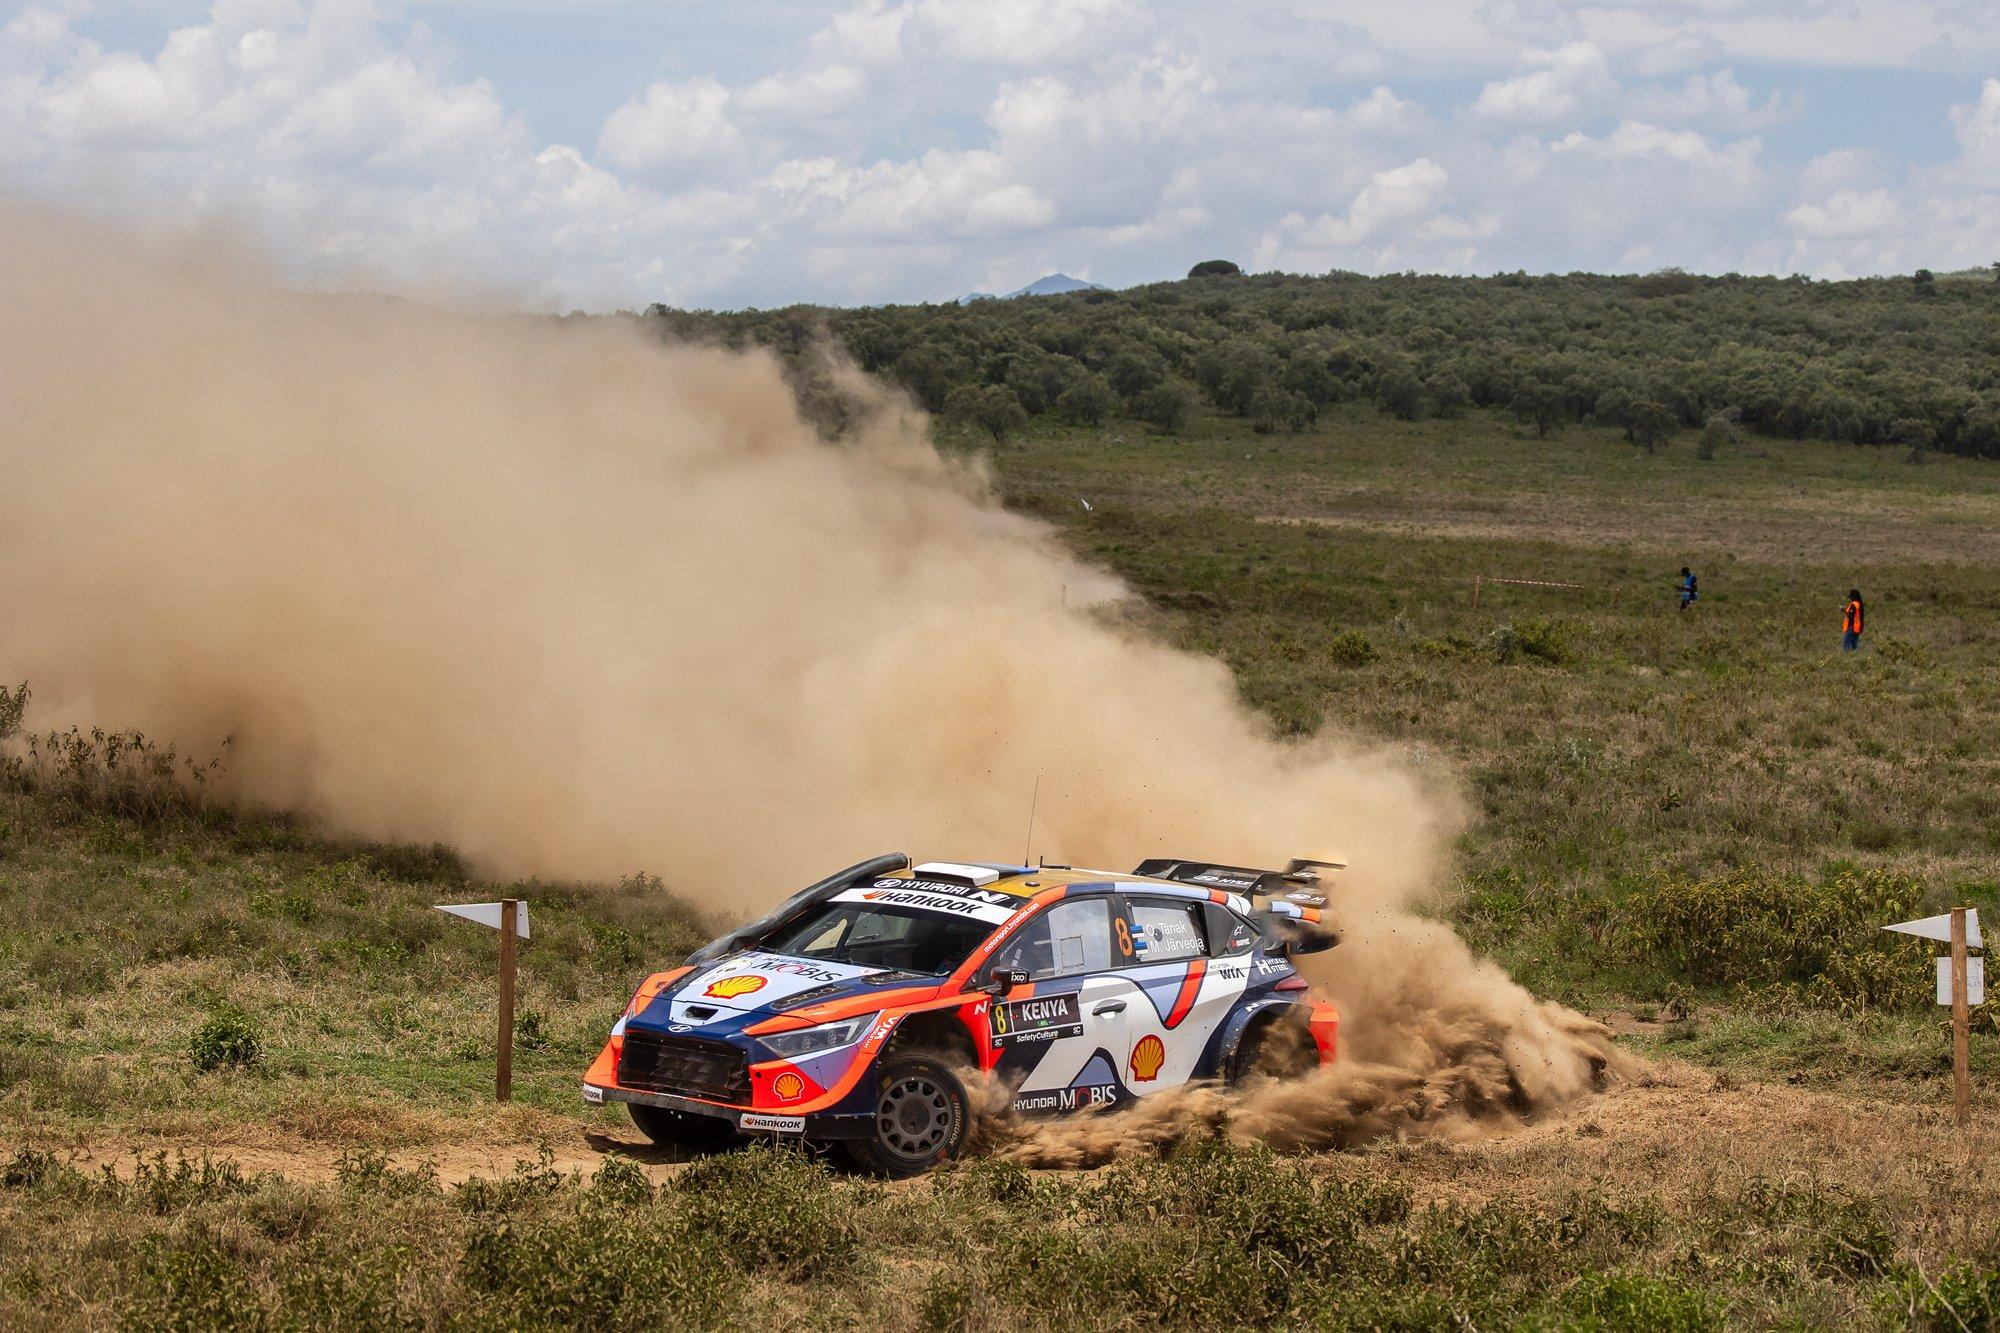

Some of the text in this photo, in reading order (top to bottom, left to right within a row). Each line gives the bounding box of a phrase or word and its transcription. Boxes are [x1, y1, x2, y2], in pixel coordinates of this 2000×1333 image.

[901, 880, 970, 895] HYUNDAI
[983, 902, 1041, 954] motorsport.hyundai.com
[1114, 917, 1133, 957] 8
[752, 958, 842, 982] MOBIS
[994, 1005, 1007, 1034] 8
[1022, 999, 1069, 1022] KENYA
[1016, 1030, 1059, 1043] SafetyCulture
[1013, 1085, 1117, 1111] HYUNDAI MOBIS
